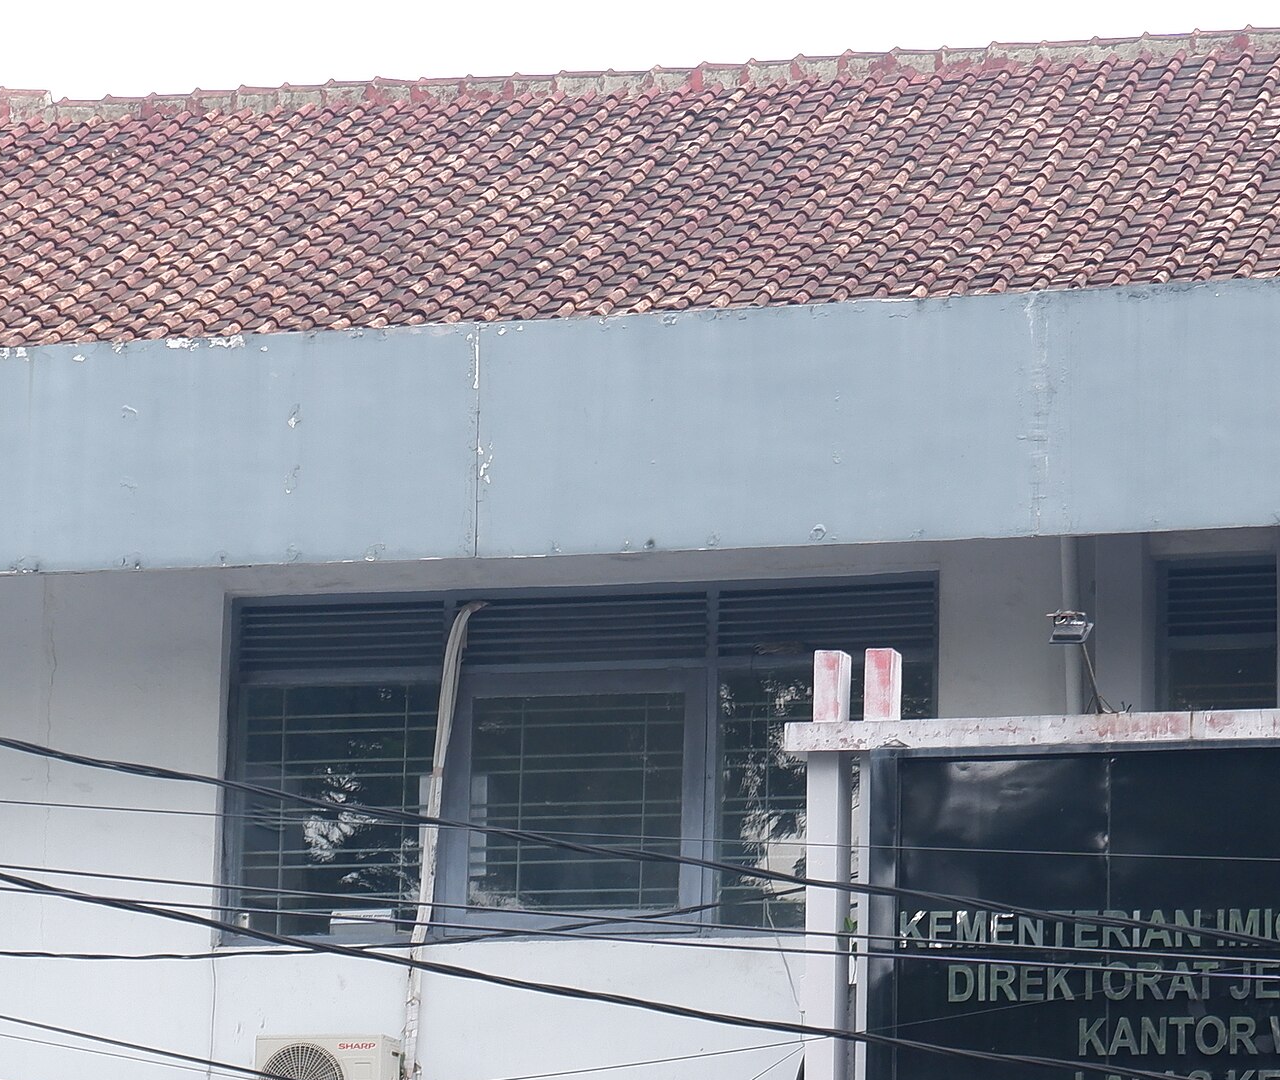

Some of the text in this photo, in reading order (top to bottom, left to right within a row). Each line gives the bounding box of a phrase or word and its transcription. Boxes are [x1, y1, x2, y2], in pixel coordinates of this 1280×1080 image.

[898, 909, 1202, 950] KEMENTERIAN
[947, 961, 1219, 1003] DIREKTORAT
[337, 1042, 376, 1050] SHARP
[1078, 1014, 1257, 1056] KANTOR
